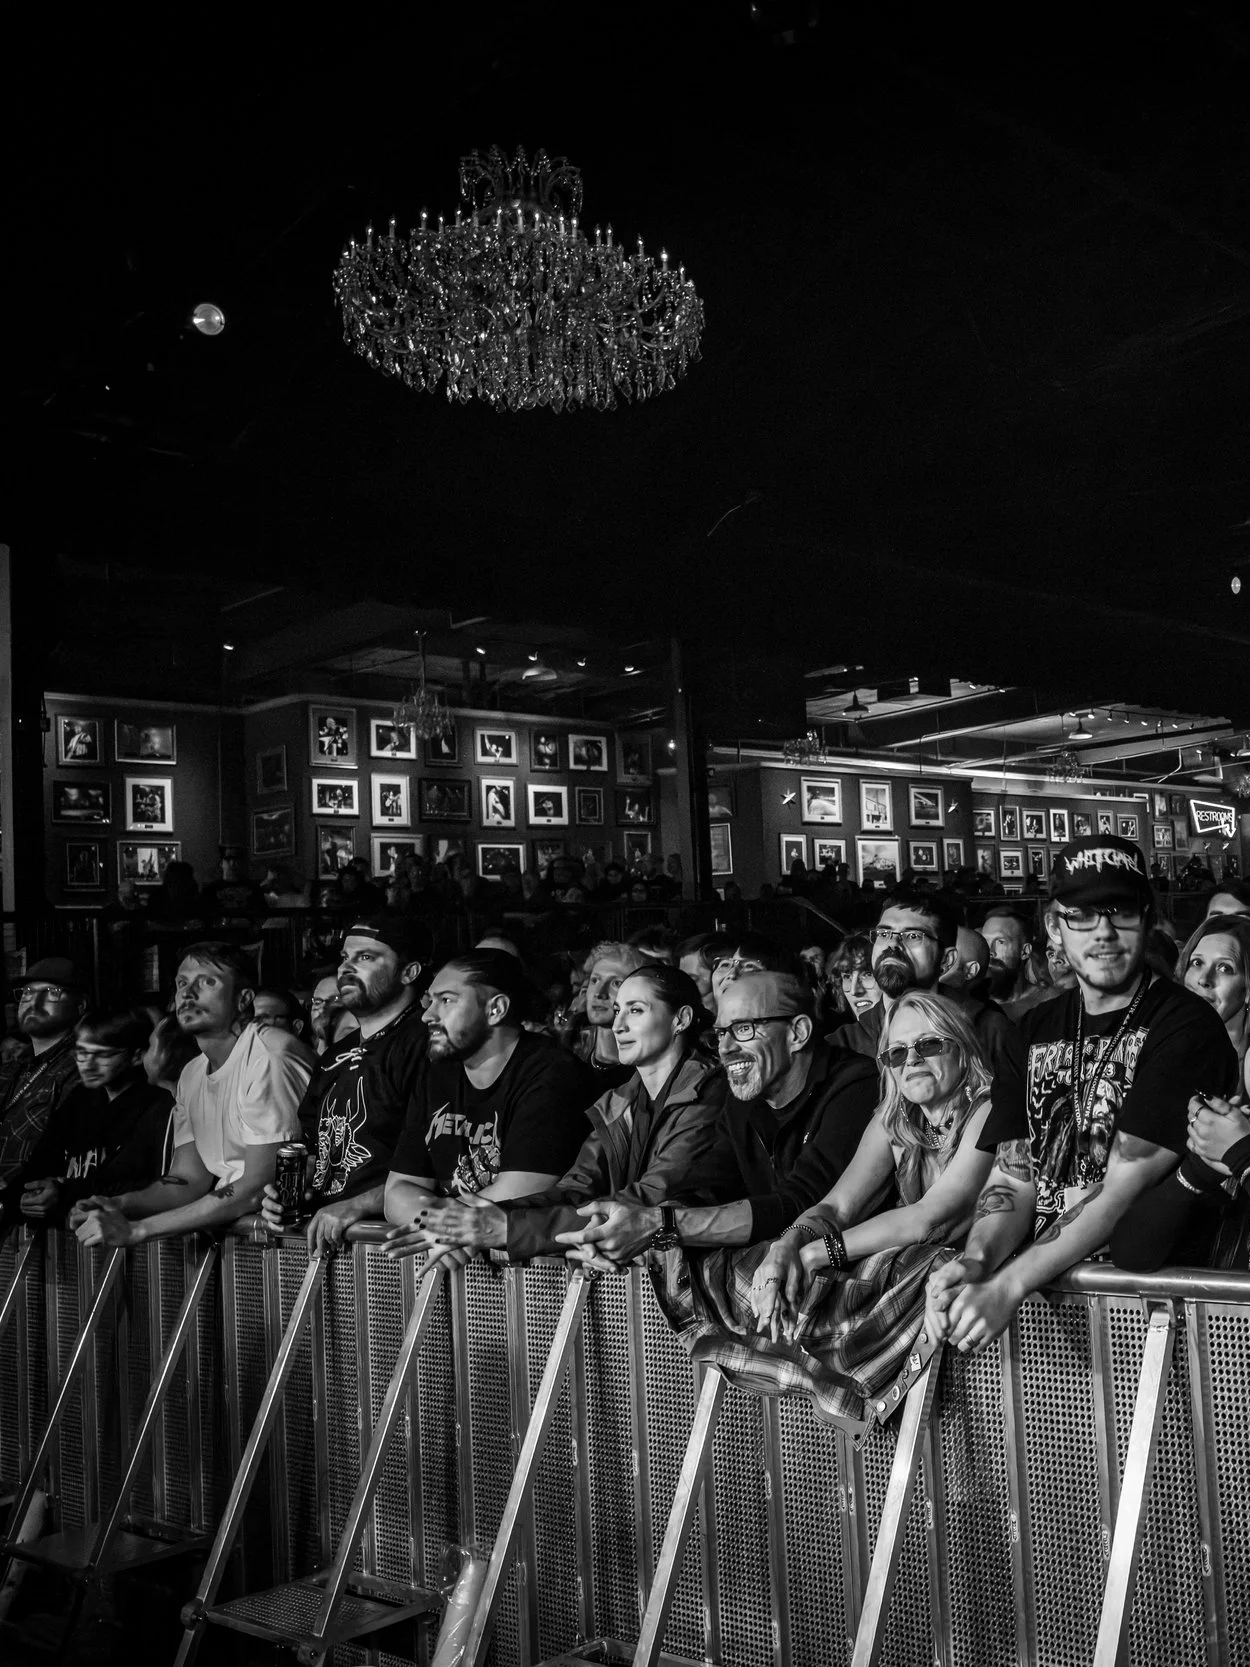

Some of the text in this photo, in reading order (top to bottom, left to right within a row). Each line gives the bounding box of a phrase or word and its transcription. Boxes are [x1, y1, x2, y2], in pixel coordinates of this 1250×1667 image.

[1196, 810, 1233, 823] RESTROOMS
[1129, 985, 1147, 1015] MASTO
[1102, 1025, 1125, 1062] MASTODON
[1073, 1092, 1083, 1131] MASTODO
[1084, 1075, 1099, 1118] MASTODON
